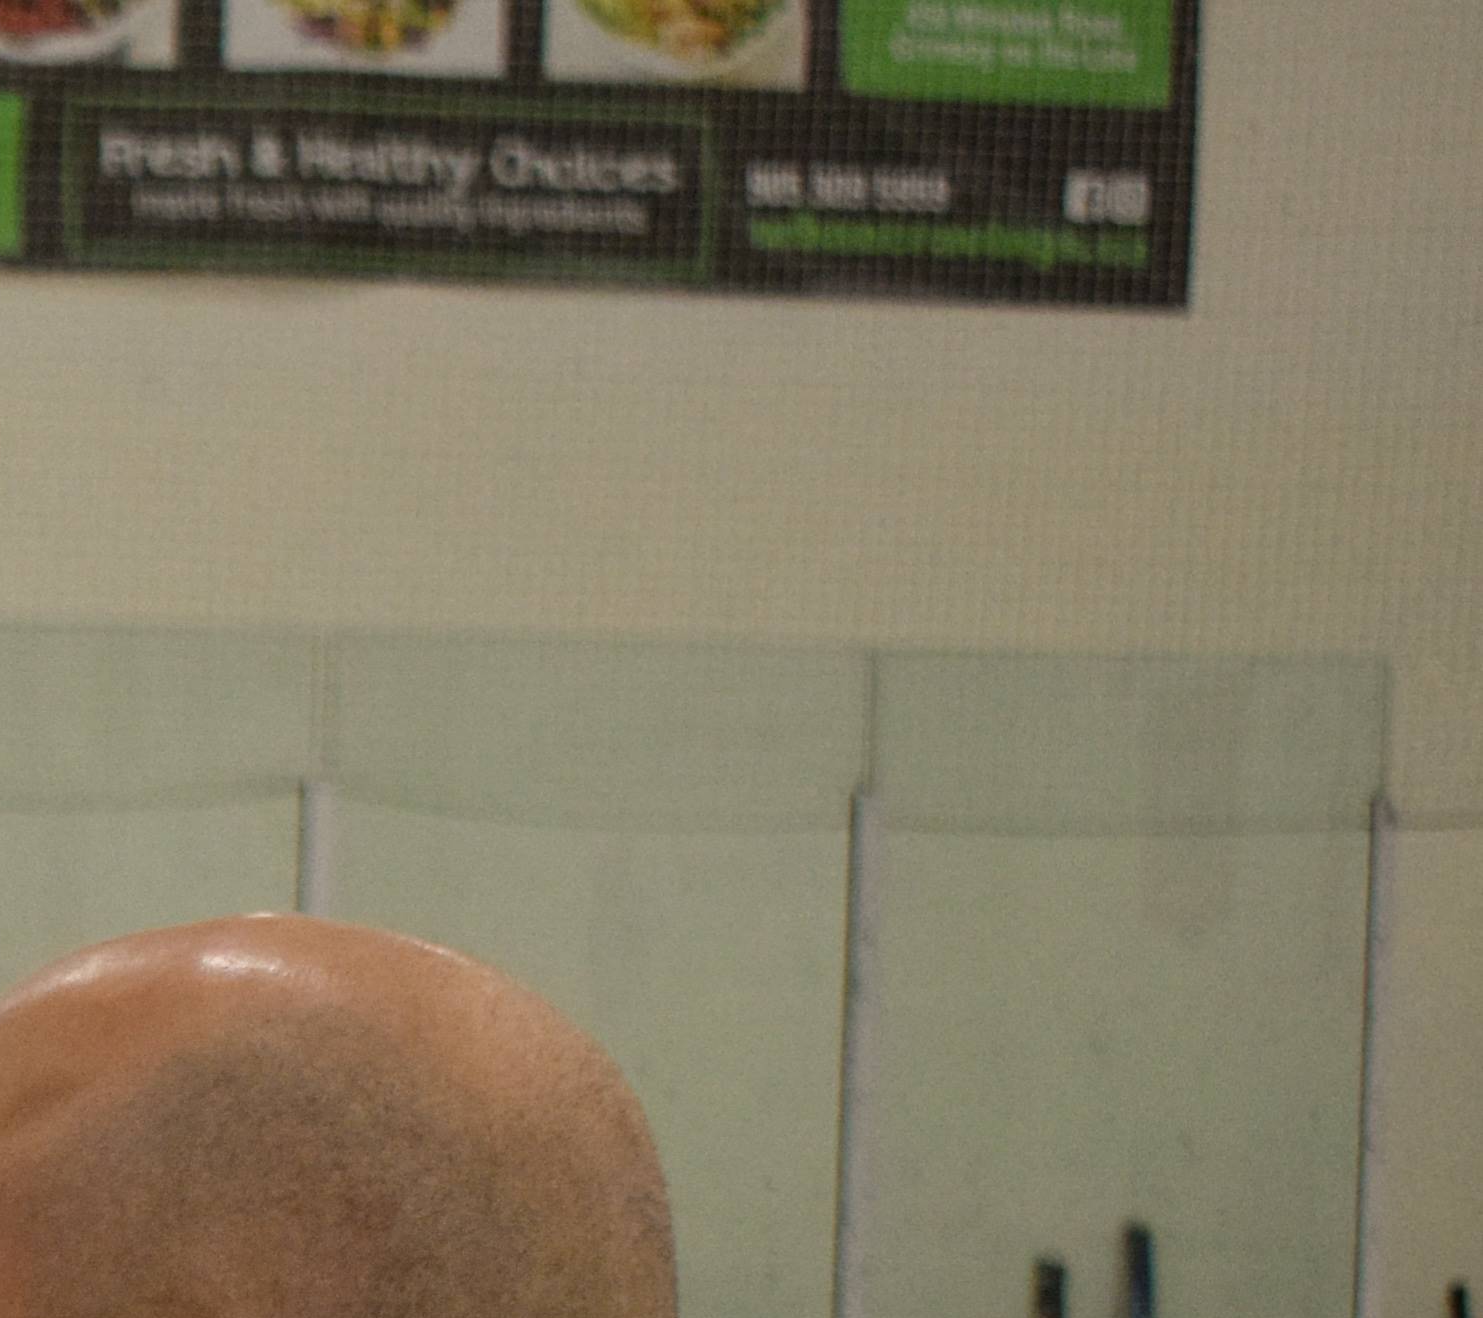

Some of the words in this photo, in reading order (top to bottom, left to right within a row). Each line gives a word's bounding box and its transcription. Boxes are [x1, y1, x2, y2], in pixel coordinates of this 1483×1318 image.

[97, 130, 240, 179] Fresh
[251, 132, 285, 179] &
[297, 133, 480, 198] Healthy
[489, 136, 681, 193] Choices
